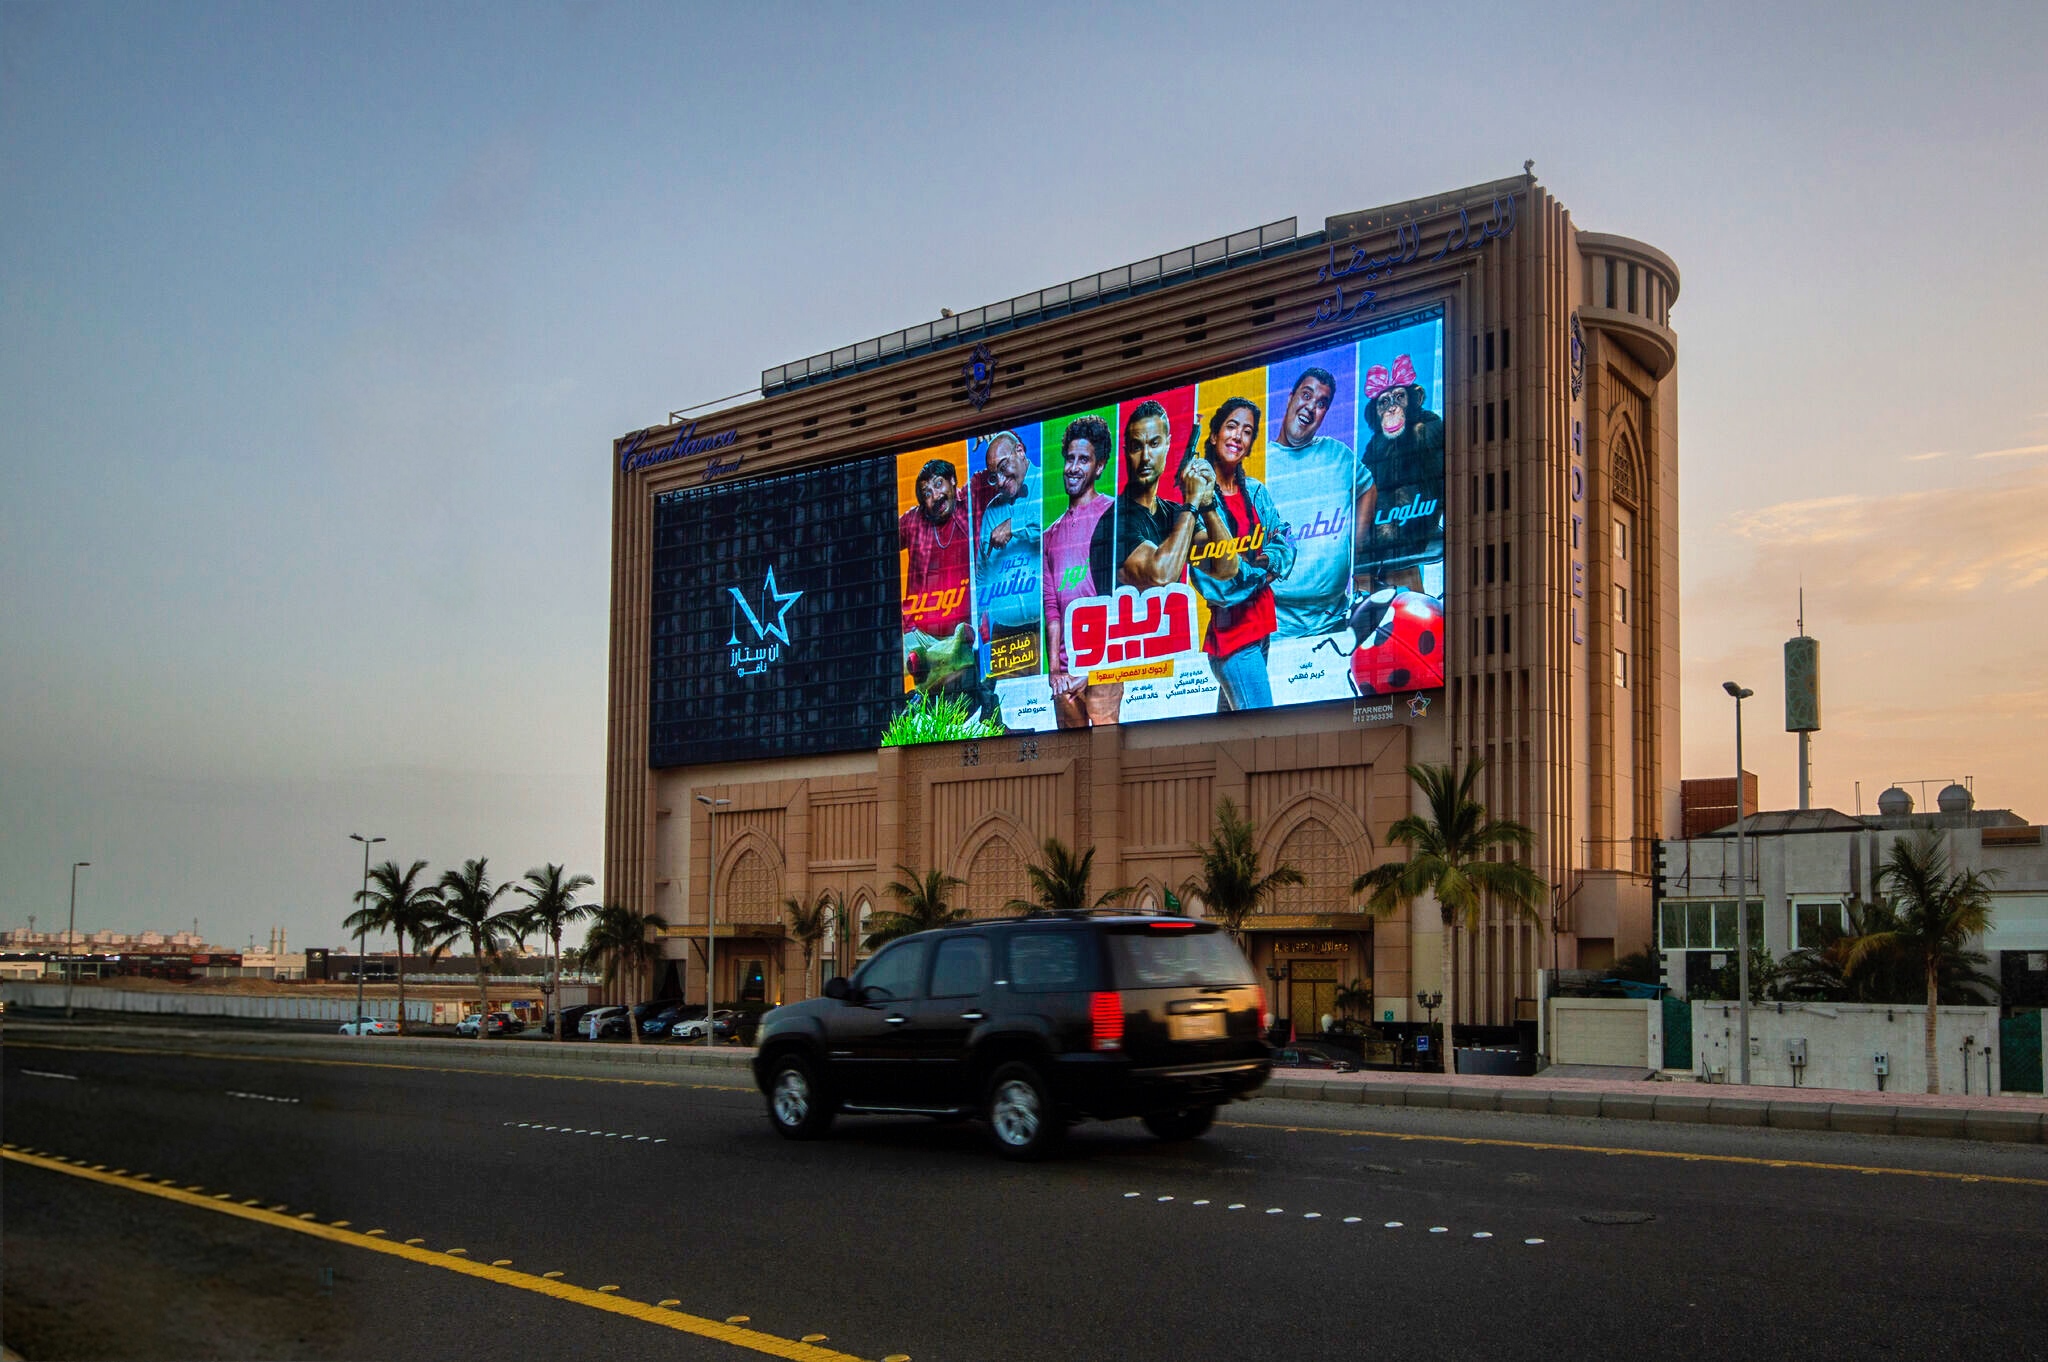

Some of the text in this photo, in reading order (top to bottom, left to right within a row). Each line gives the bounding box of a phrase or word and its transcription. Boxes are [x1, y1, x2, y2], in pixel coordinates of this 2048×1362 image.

[1318, 192, 1517, 282] الدار البيضاء
[1305, 285, 1377, 328] جراند
[618, 422, 737, 474] Casablanca
[702, 455, 744, 480] Grand
[1375, 493, 1438, 527] سلوى
[1571, 416, 1584, 646] HOTEL
[1189, 523, 1267, 566] ناعومي
[1000, 551, 1030, 573] دكتور
[1058, 558, 1091, 592] نور
[902, 578, 970, 621] توحيد
[1072, 592, 1191, 667] ديدو
[730, 647, 767, 667] ستارز
[990, 636, 1031, 657] فيلم عيد
[1008, 650, 1034, 668] الفطر
[1148, 663, 1168, 675] أرجوك
[1195, 676, 1208, 685] كريم
[1288, 669, 1325, 684] كريم فهمي
[1187, 685, 1201, 694] أحمد
[1033, 706, 1047, 714] عمرو
